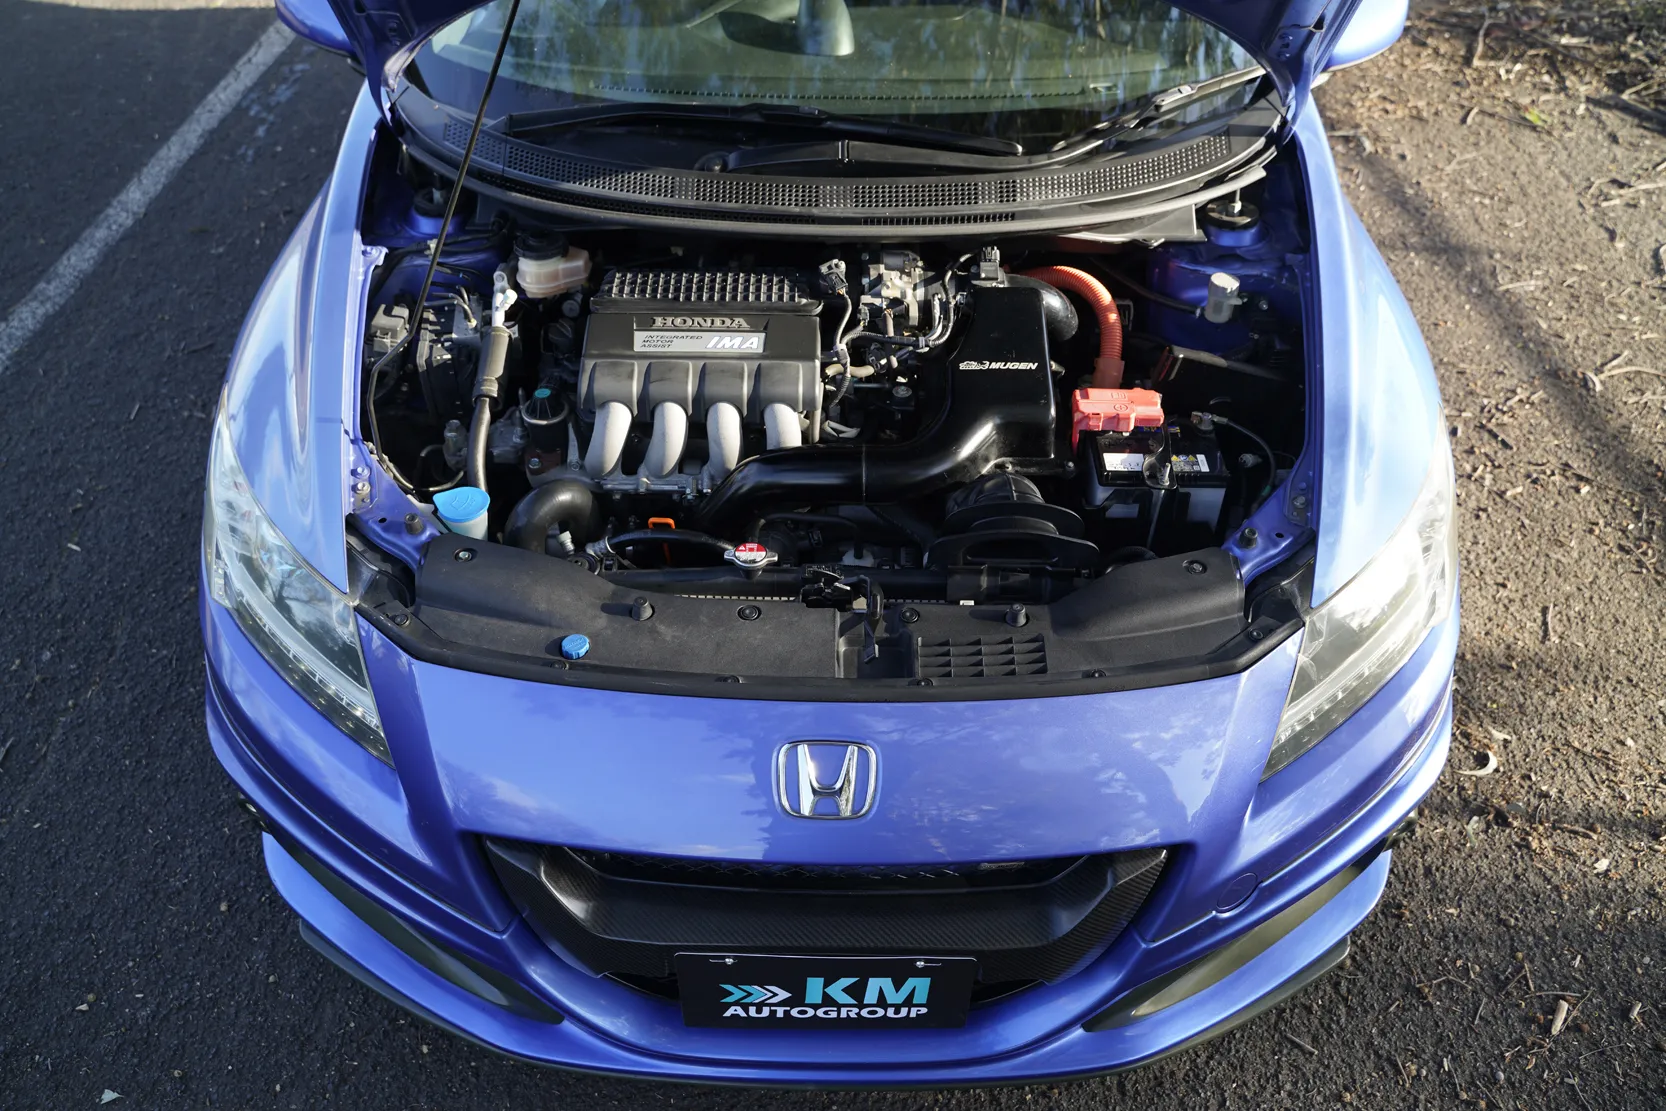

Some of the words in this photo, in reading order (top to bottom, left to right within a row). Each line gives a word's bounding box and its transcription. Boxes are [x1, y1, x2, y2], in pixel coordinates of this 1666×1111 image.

[651, 316, 751, 328] HONDA
[705, 336, 759, 349] IMA
[989, 361, 1038, 370] MUGEN
[804, 977, 932, 1004] KM
[722, 1005, 928, 1019] AUTOGROUP
